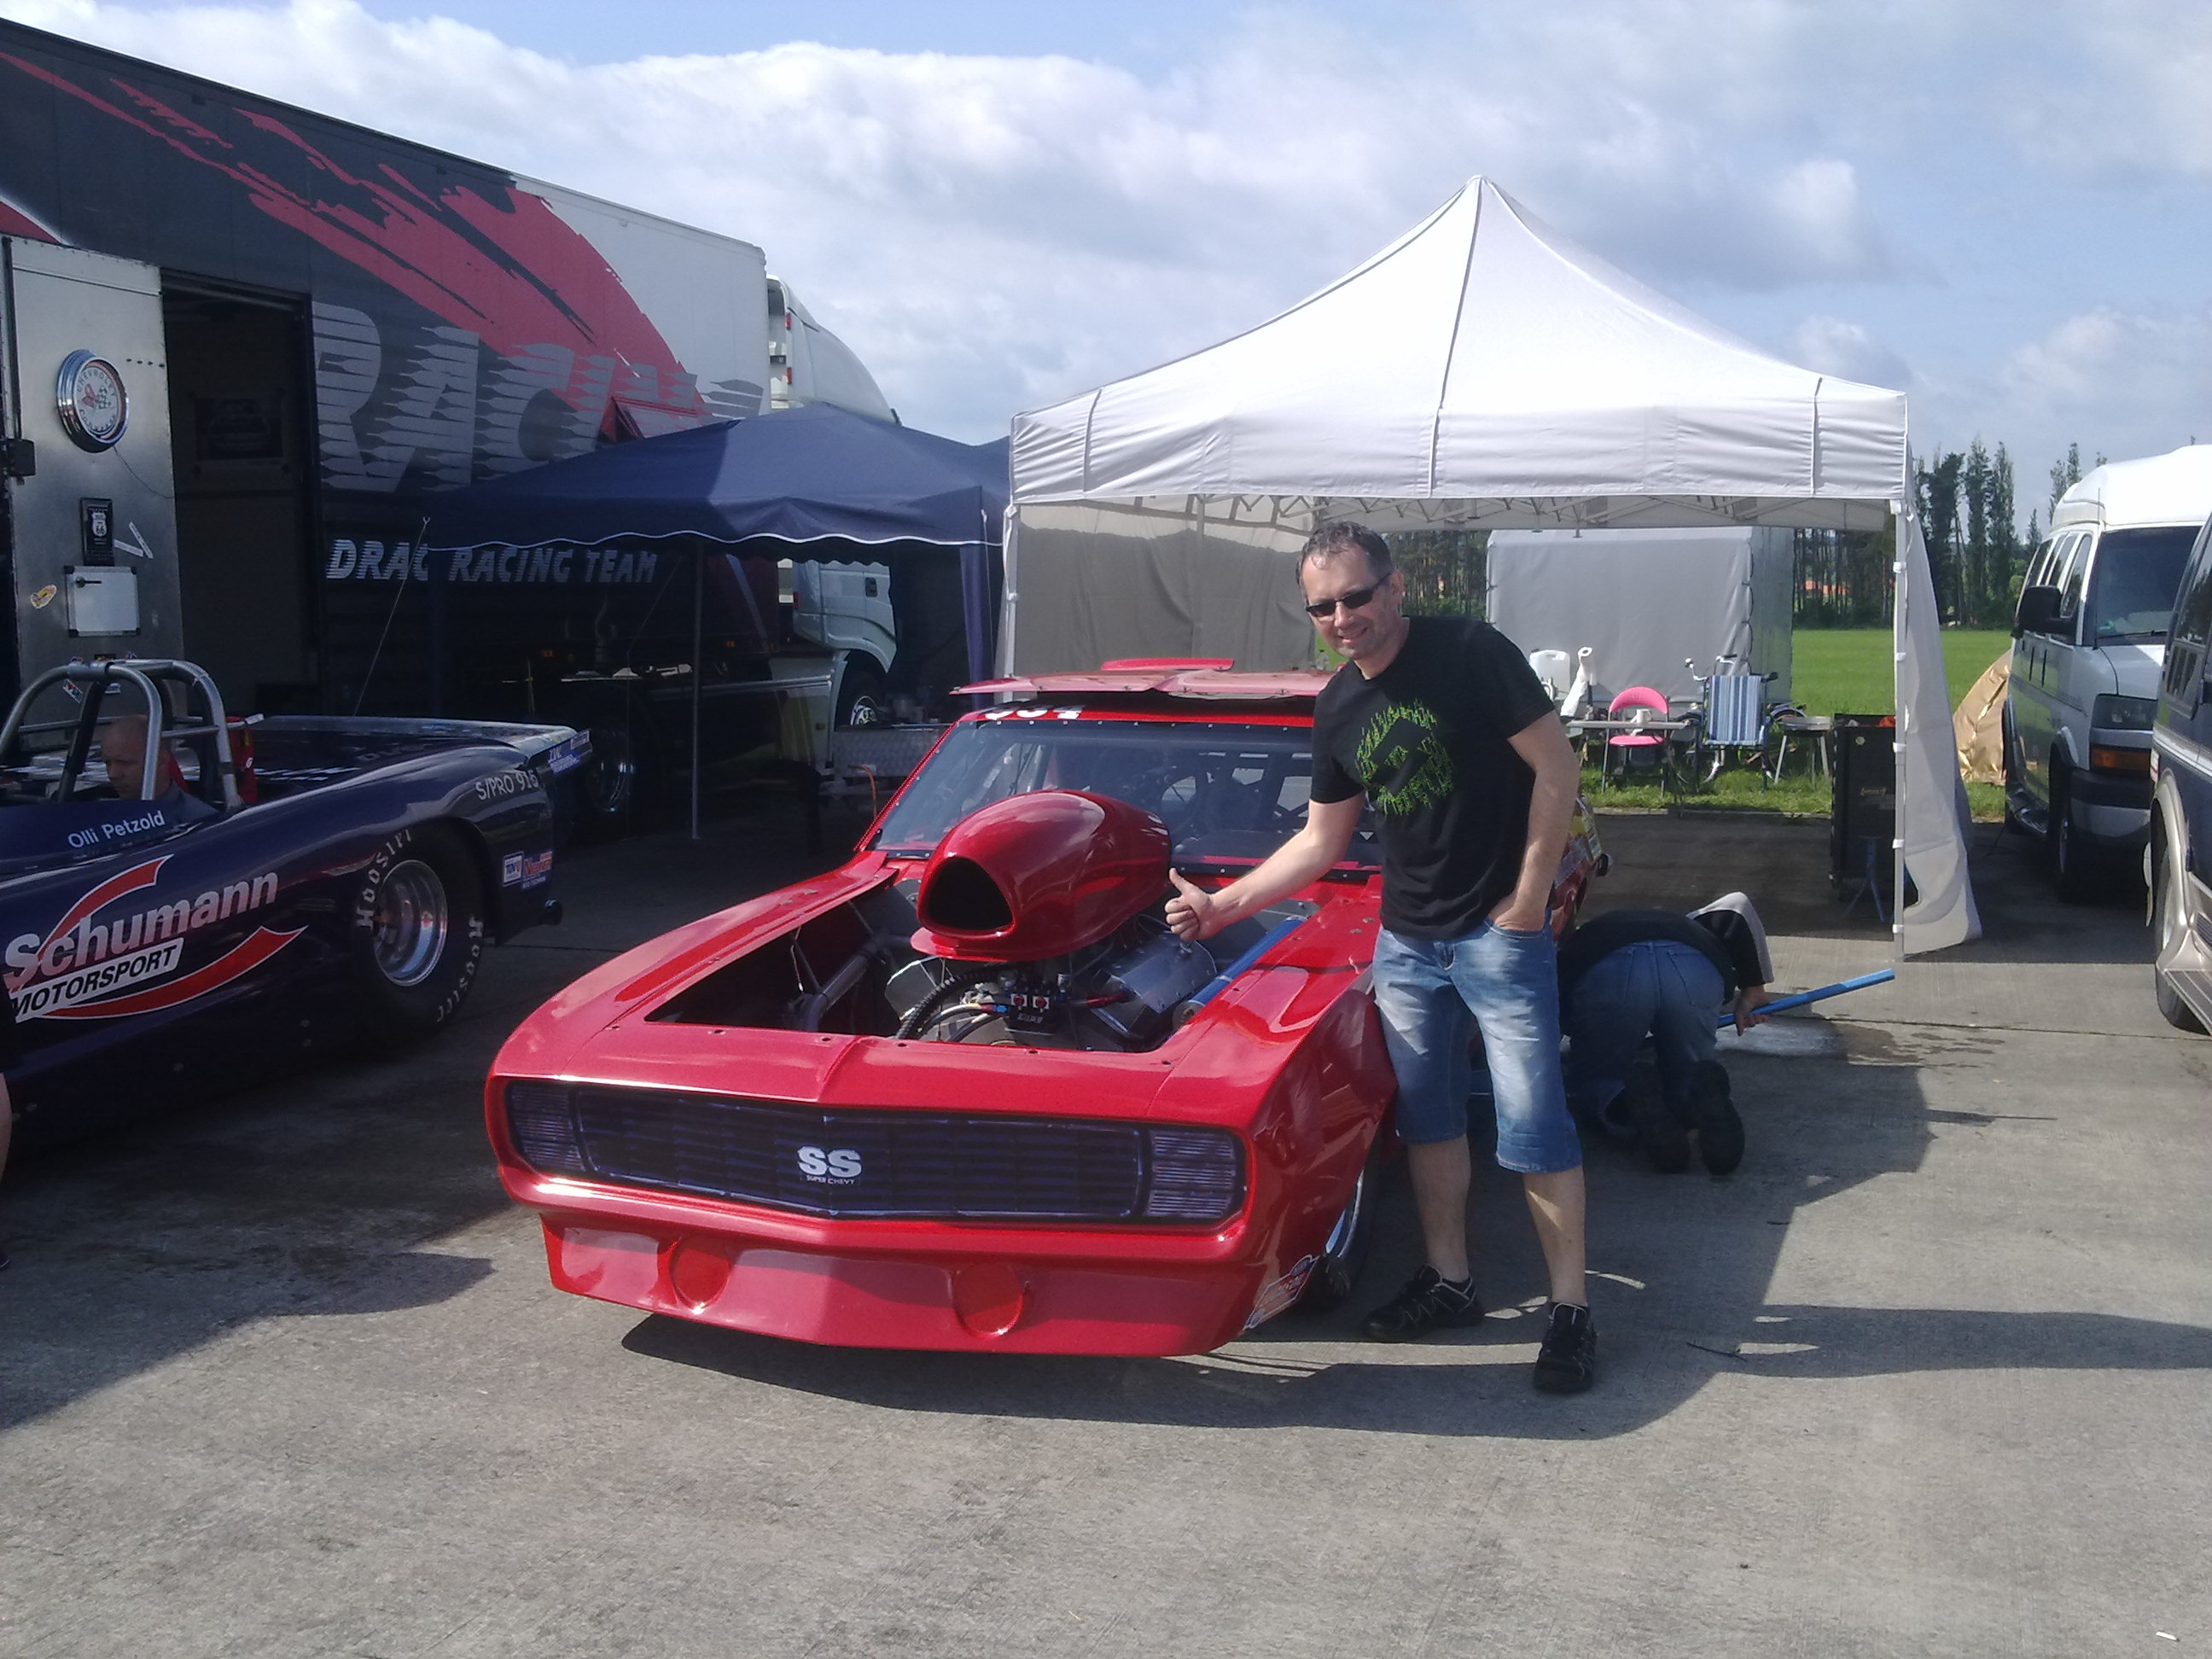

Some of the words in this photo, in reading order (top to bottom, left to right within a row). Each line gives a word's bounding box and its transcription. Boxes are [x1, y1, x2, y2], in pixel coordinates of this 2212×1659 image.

[96, 525, 105, 534] 66
[448, 547, 573, 583] RACING
[583, 549, 658, 583] TEAM
[475, 775, 515, 800] S/PRO
[67, 828, 100, 848] Olli
[102, 810, 166, 840] Petzold
[3, 871, 279, 990] Schumann
[11, 944, 178, 1015] MOTORSPORT
[796, 1145, 862, 1178] SS
